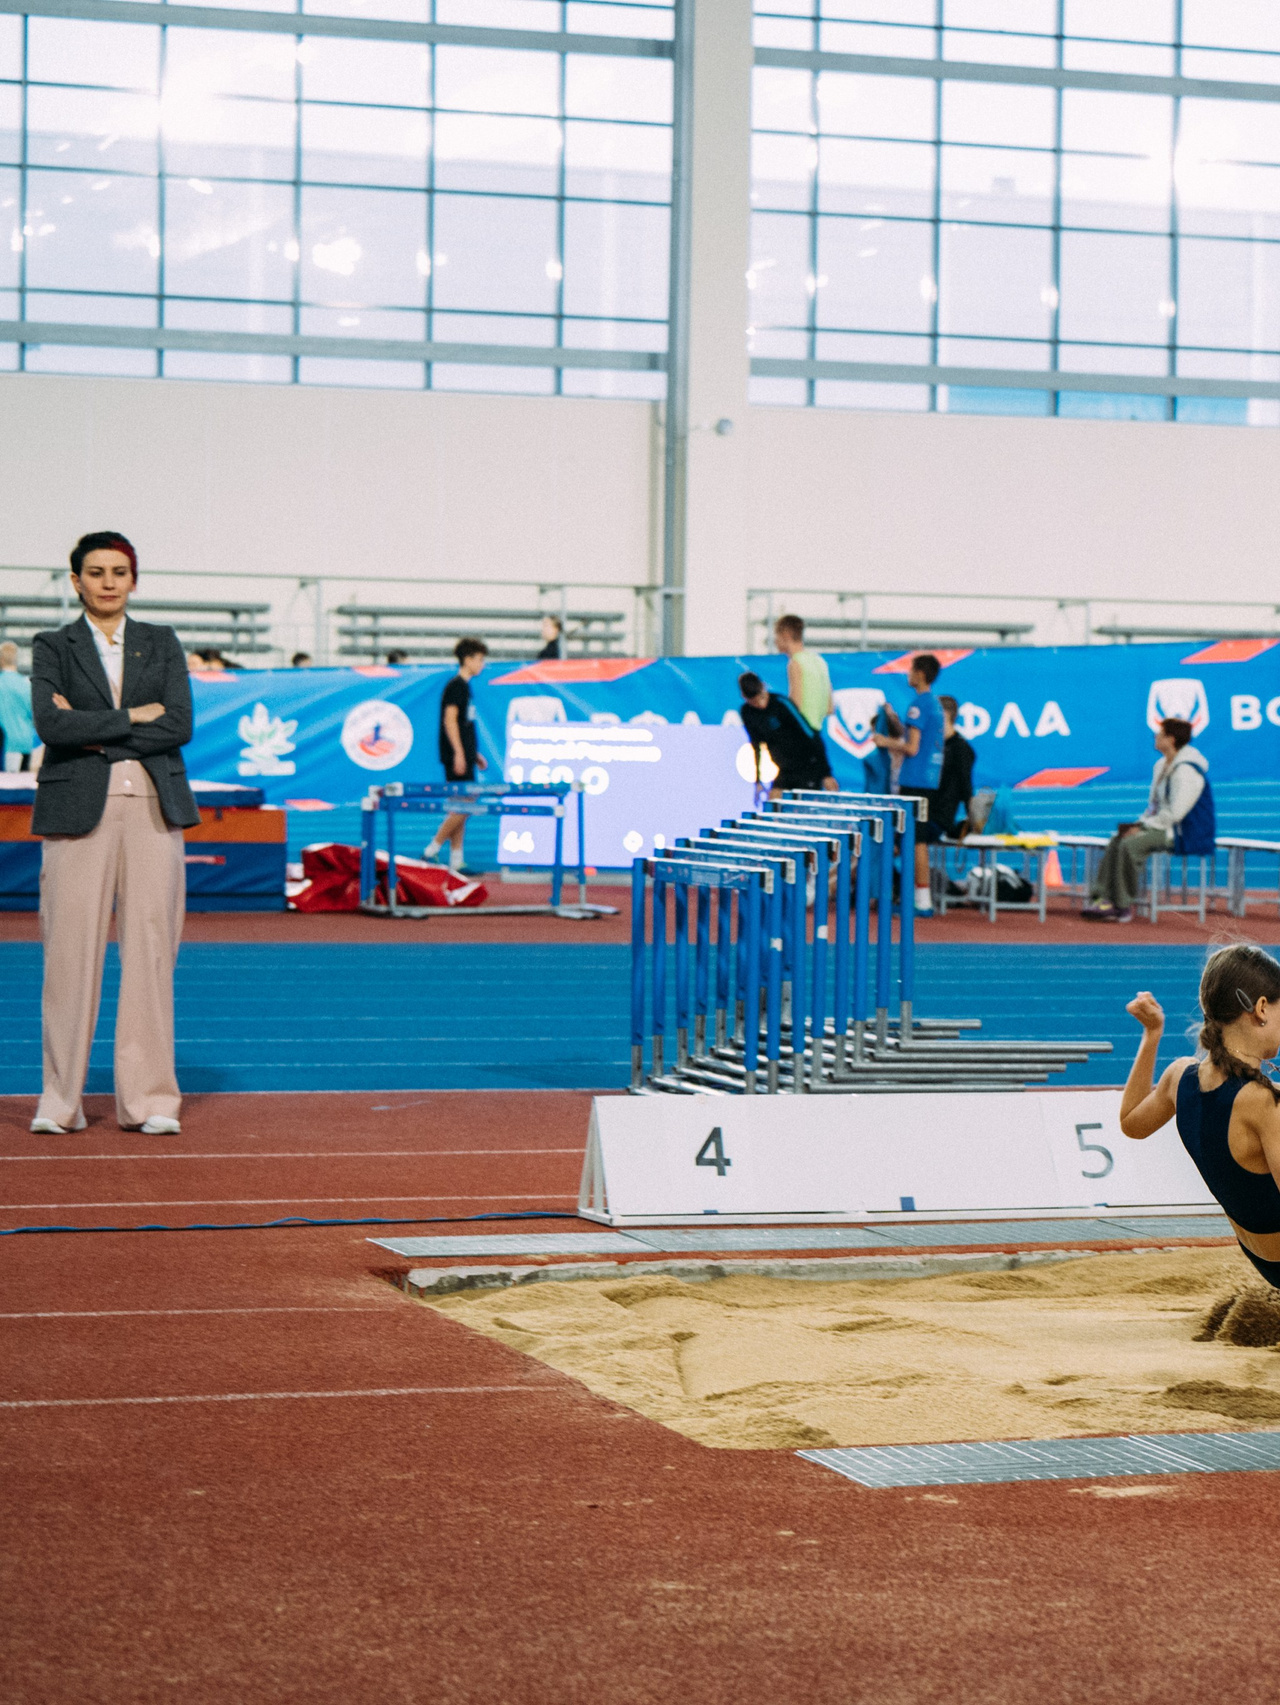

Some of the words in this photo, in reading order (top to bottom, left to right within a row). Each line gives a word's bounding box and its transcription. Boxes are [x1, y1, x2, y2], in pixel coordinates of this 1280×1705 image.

[953, 700, 1072, 741] ФЛА
[695, 1126, 732, 1177] 4
[1075, 1122, 1114, 1179] 5
